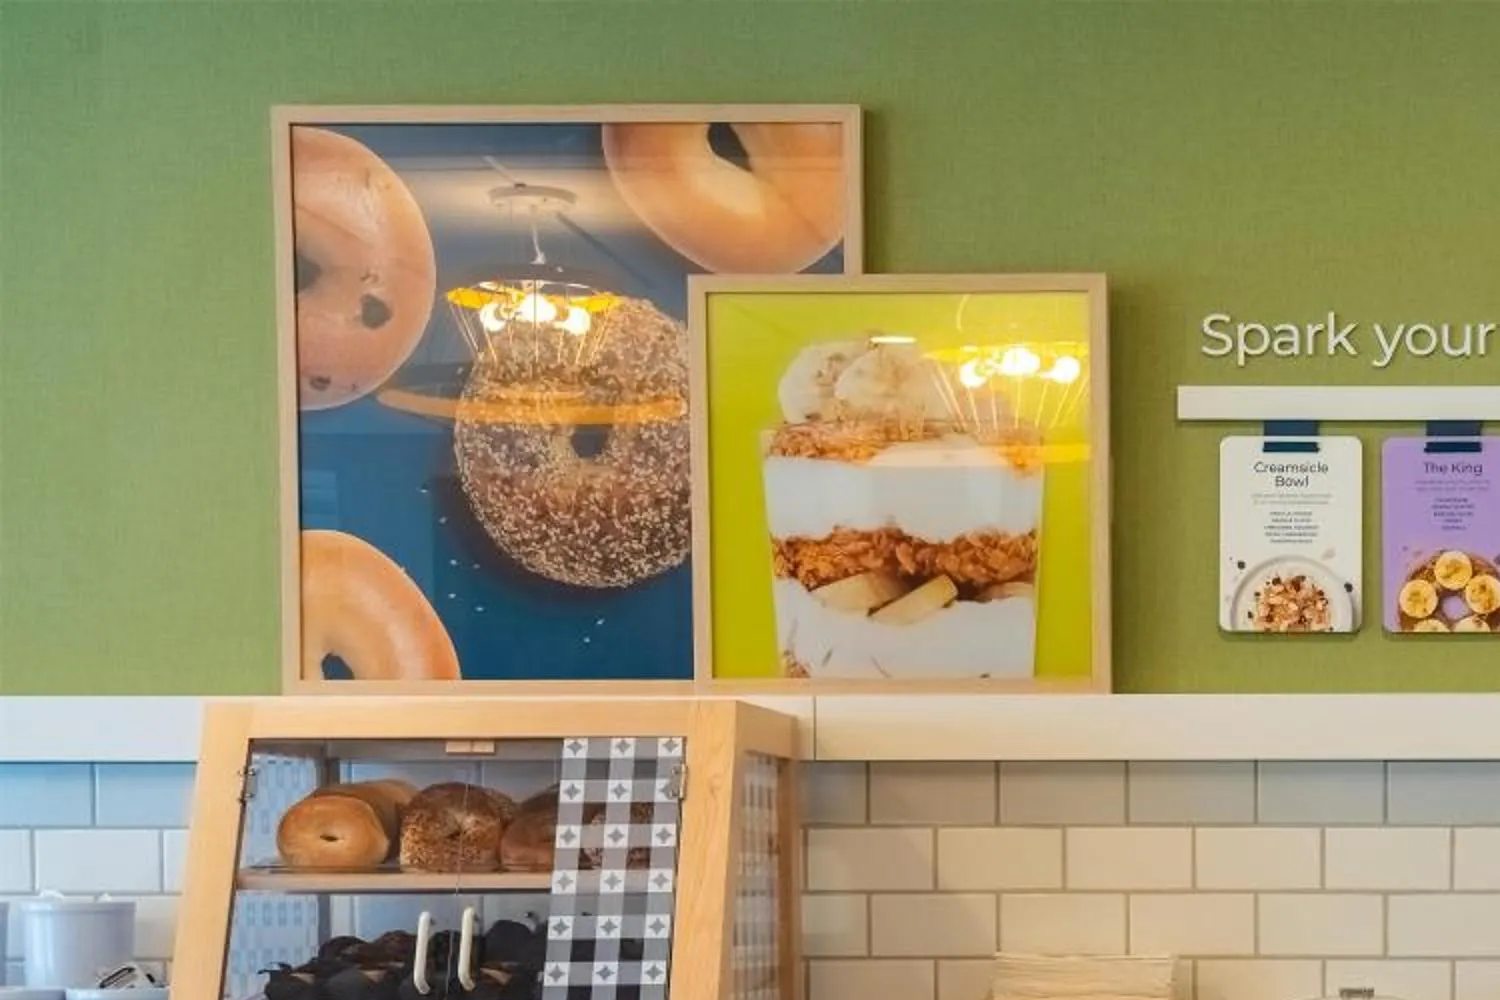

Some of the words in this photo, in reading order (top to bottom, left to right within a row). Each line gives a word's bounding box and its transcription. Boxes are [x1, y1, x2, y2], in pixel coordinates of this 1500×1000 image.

[1200, 312, 1358, 365] Spark
[1371, 322, 1497, 368] your
[1253, 461, 1329, 474] Creamsicle
[1424, 461, 1448, 474] The
[1451, 462, 1483, 477] King
[1275, 475, 1309, 488] Bowl
